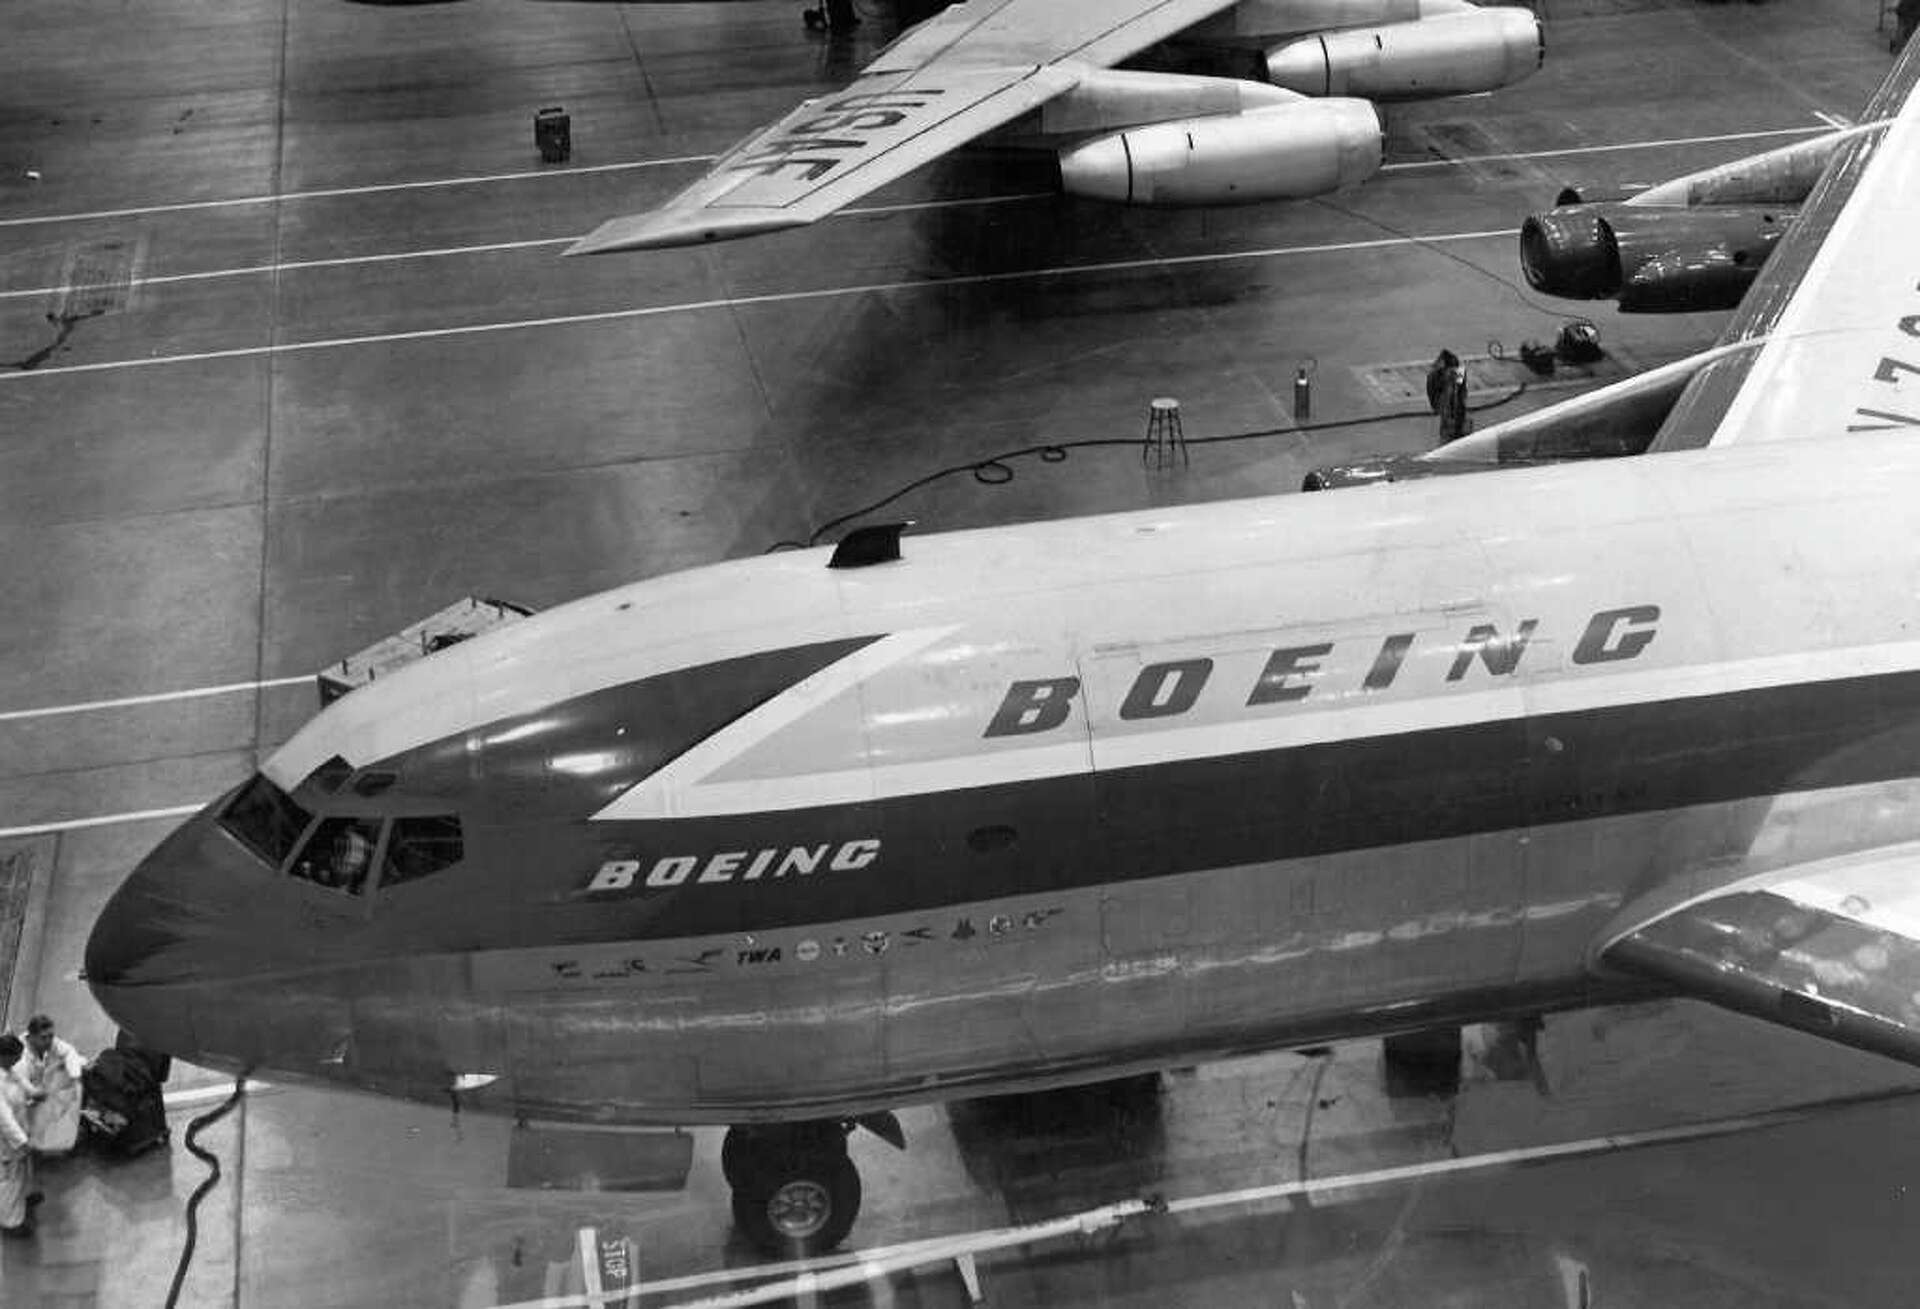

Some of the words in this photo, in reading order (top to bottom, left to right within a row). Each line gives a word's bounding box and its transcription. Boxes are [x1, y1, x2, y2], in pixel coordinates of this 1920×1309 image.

[982, 605, 1661, 738] BOEING
[587, 839, 881, 892] BOEING
[737, 948, 781, 968] TWA
